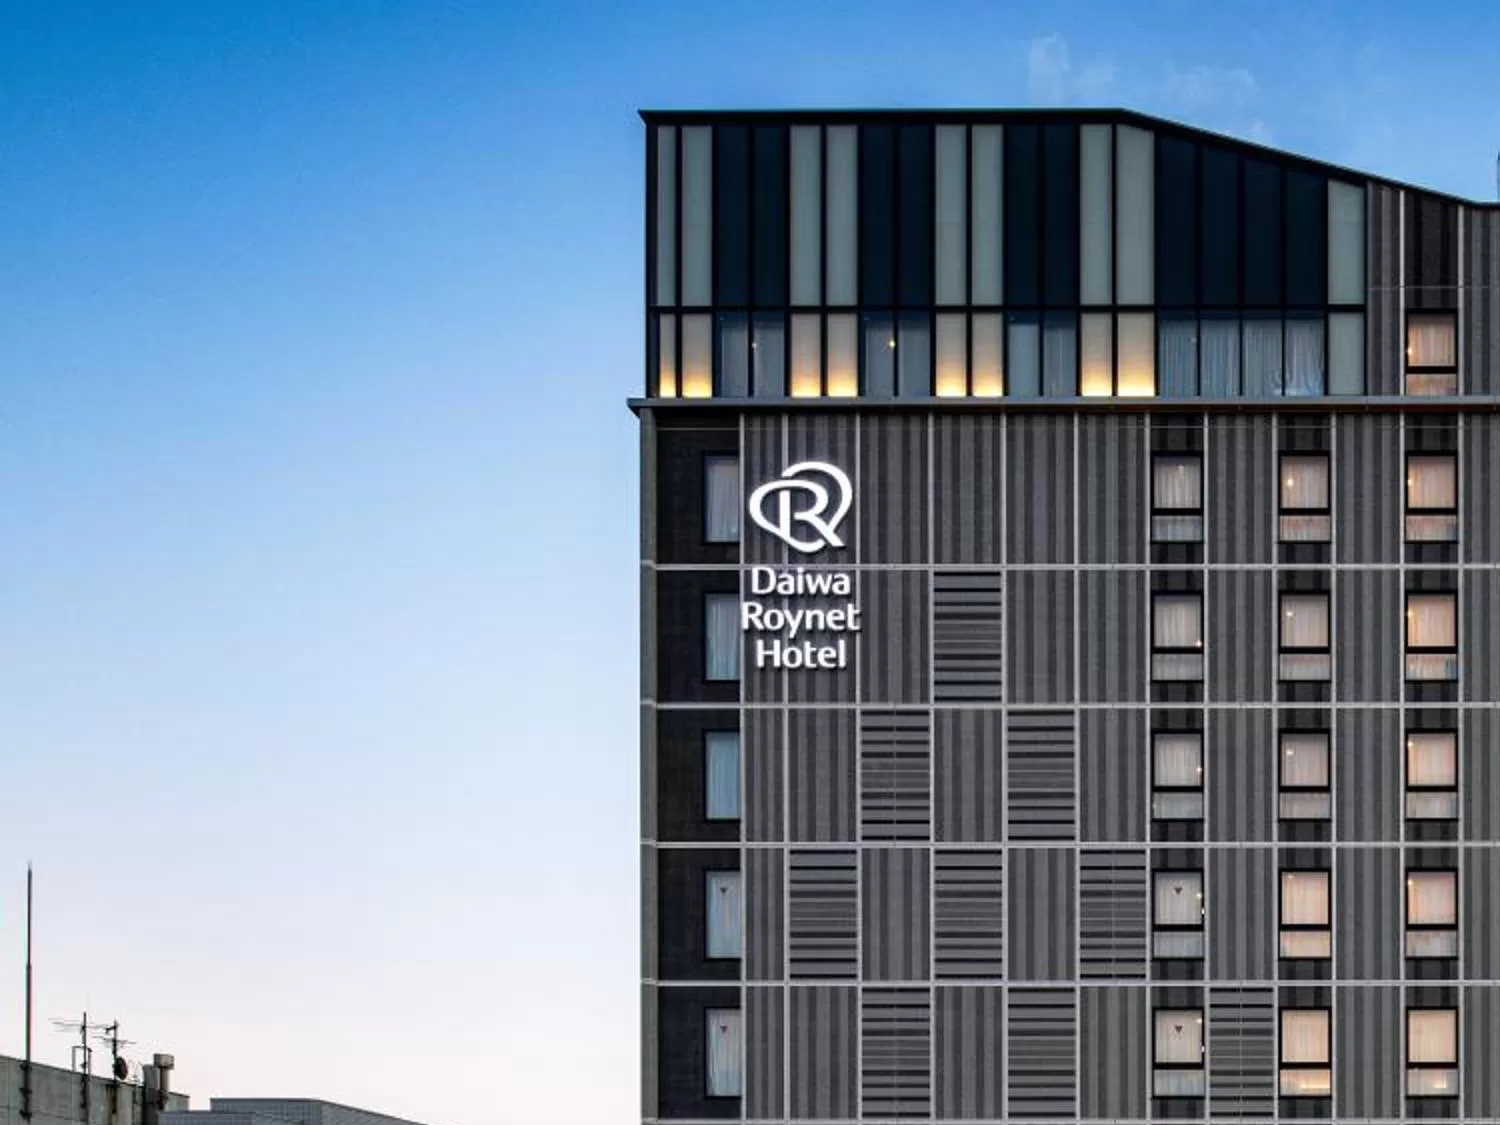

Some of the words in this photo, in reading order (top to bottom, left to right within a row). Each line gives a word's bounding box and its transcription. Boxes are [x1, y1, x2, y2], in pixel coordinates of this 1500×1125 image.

[751, 567, 850, 595] Daiwa
[742, 602, 860, 638] Roynet
[756, 639, 845, 668] Hotel
